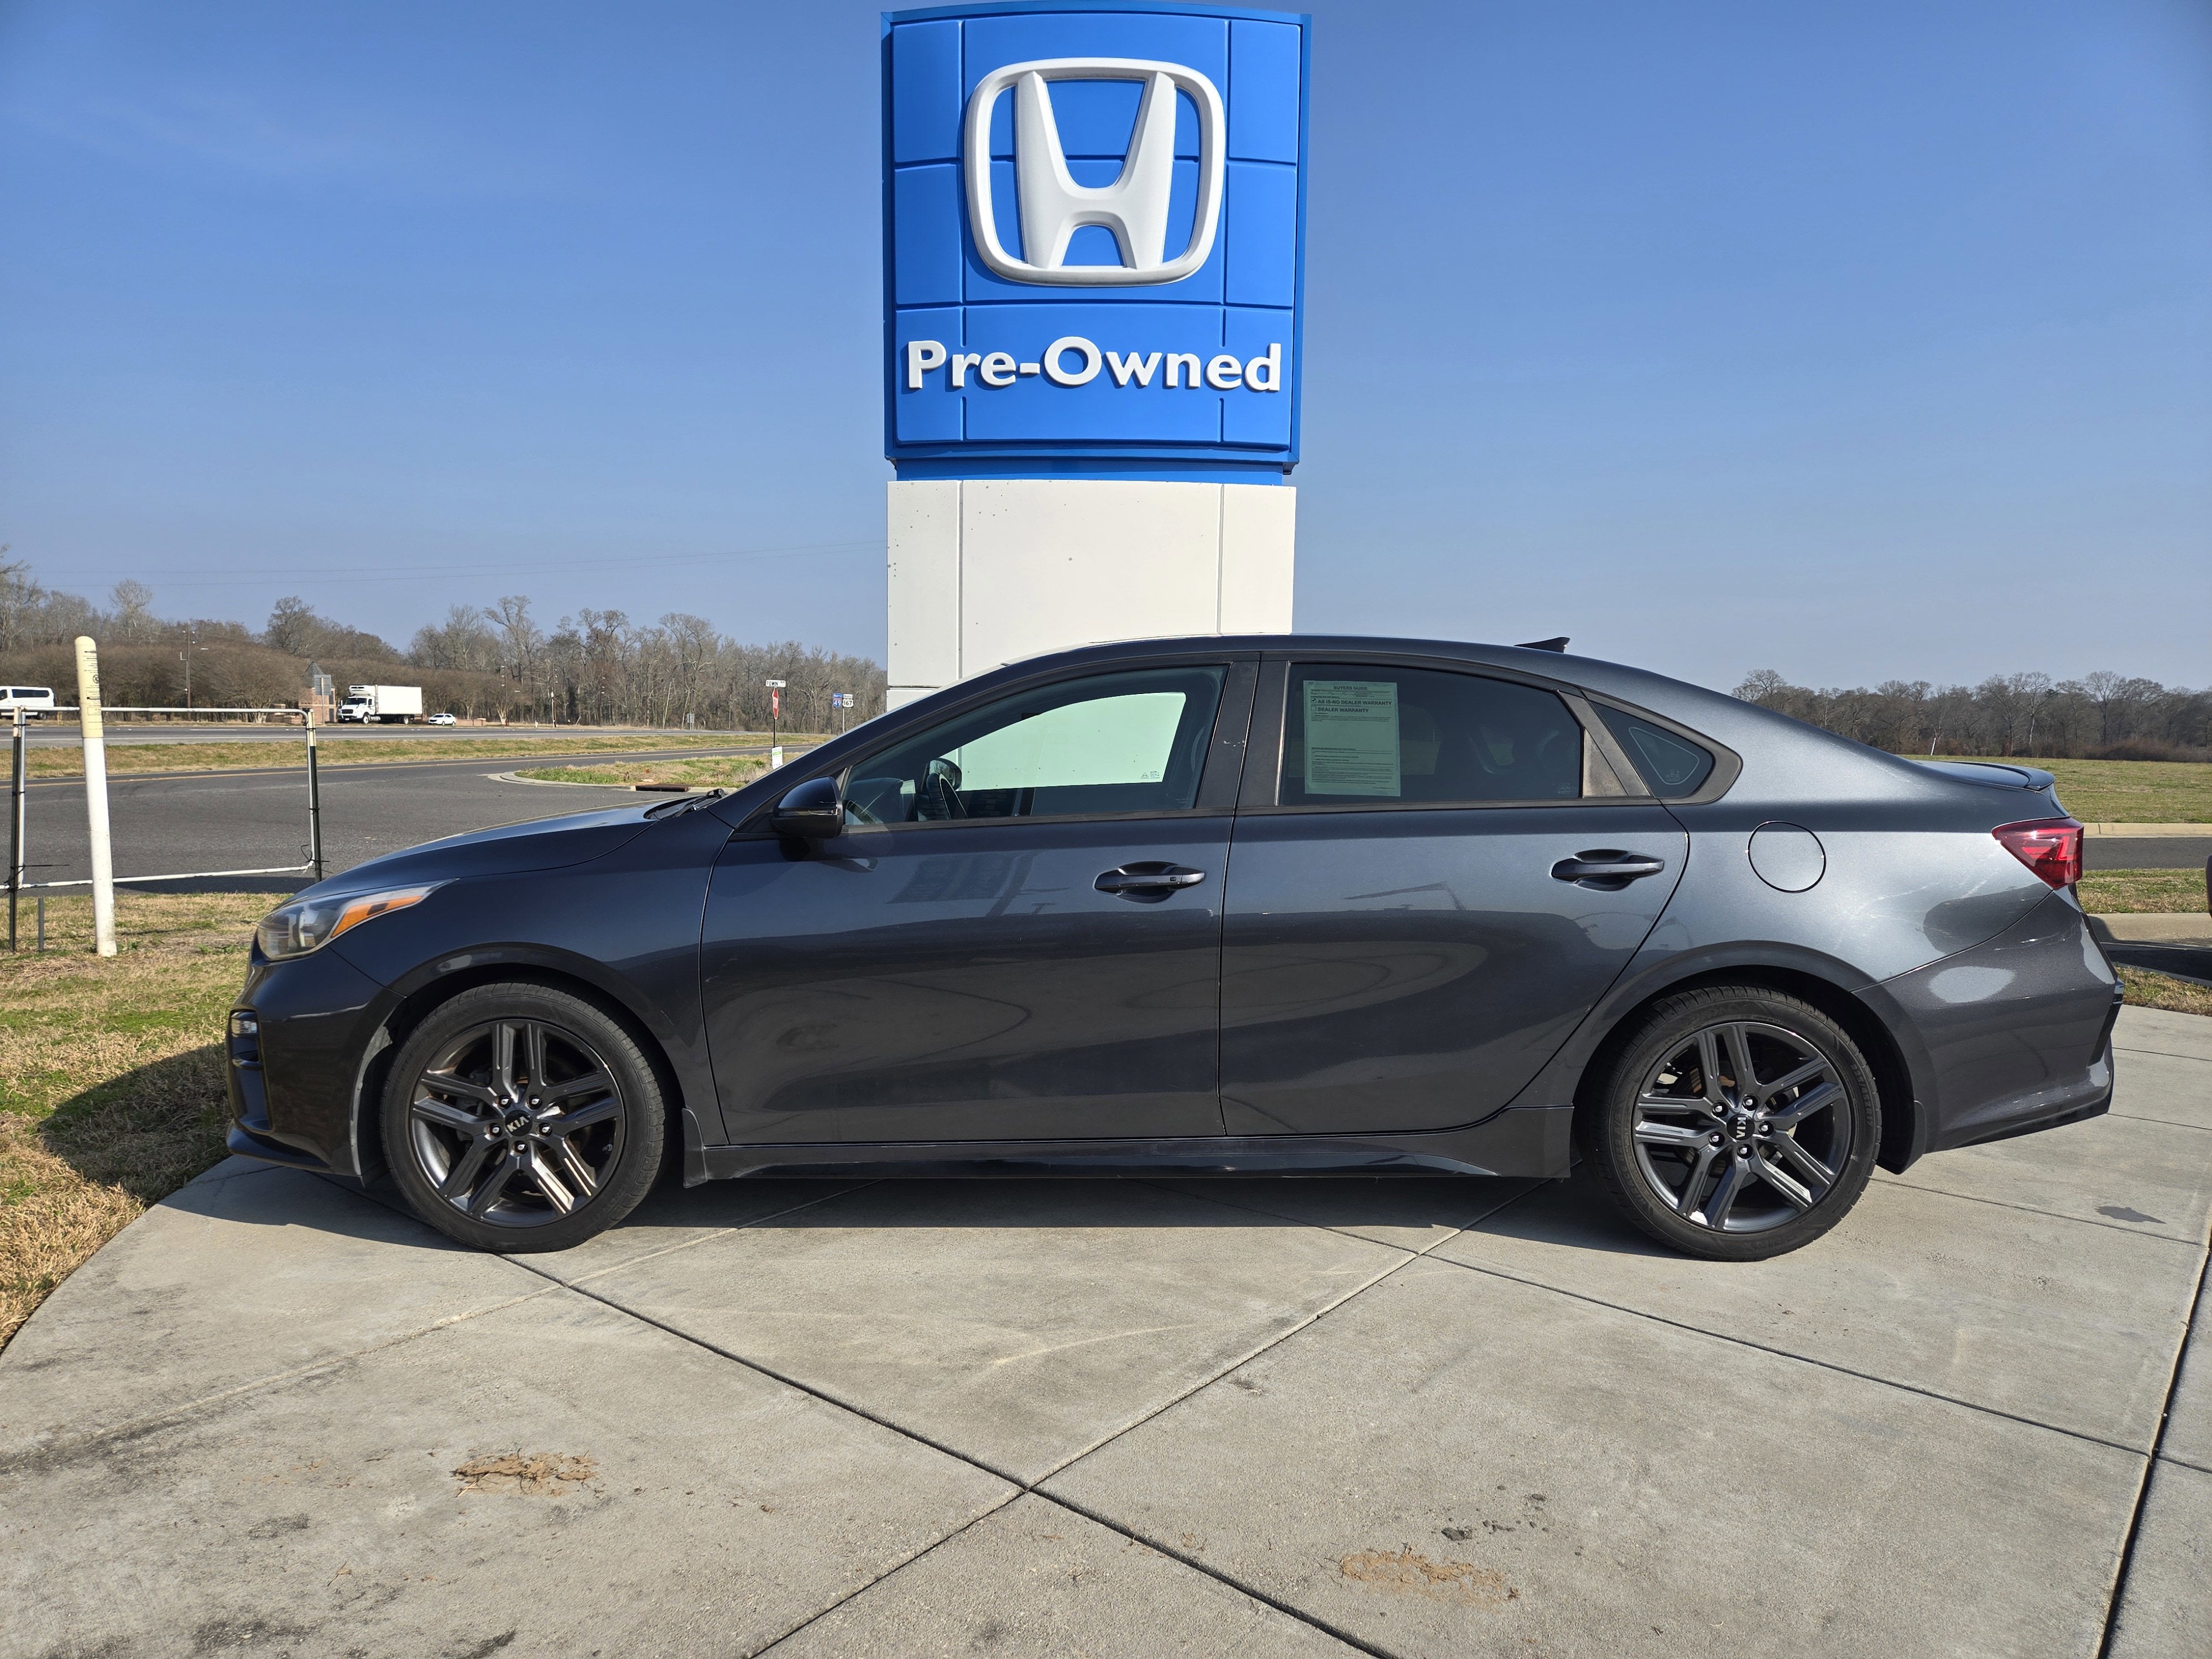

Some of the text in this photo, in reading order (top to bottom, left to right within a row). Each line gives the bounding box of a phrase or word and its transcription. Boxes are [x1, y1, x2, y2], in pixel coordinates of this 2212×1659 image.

[907, 336, 1281, 392] Pre-Owned
[507, 1116, 530, 1132] KIA
[1736, 1117, 1746, 1139] KIA
